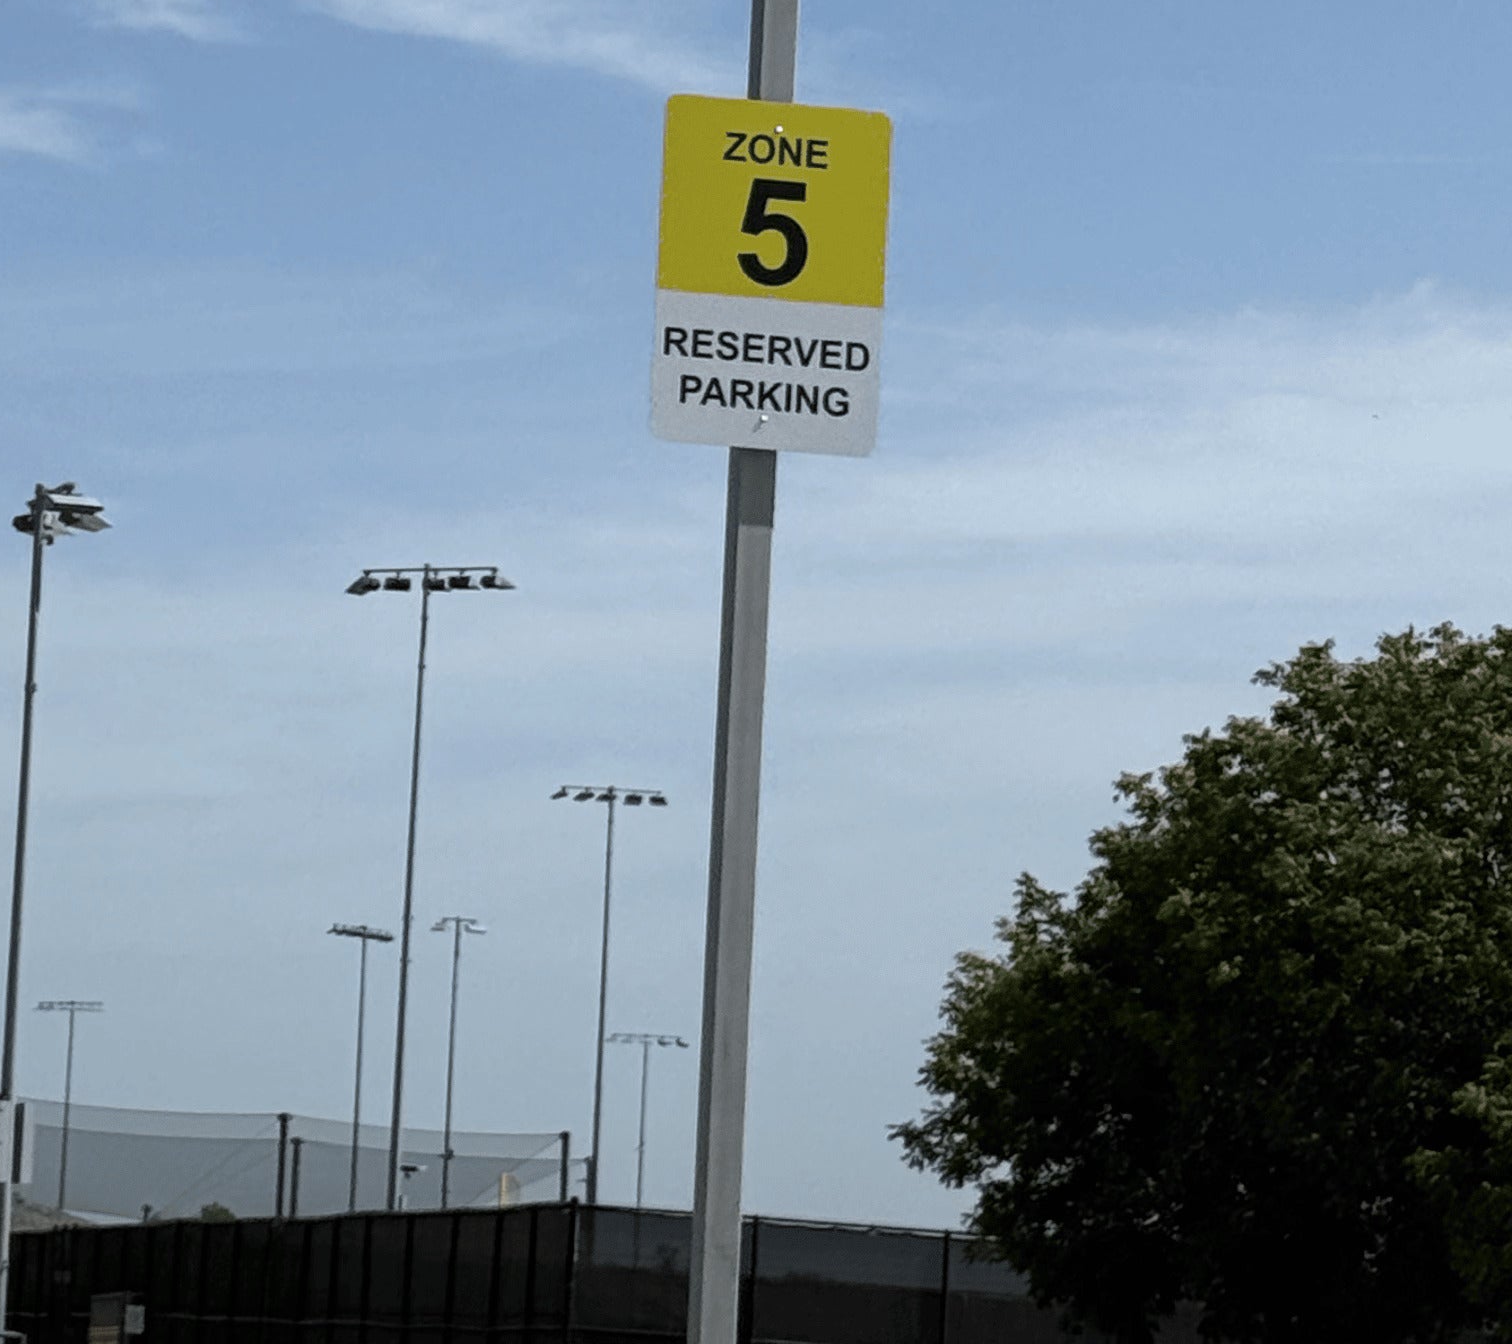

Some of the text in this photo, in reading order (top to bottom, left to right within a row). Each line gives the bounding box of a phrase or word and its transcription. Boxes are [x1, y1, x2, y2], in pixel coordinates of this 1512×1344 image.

[723, 131, 829, 170] ZONE
[737, 178, 808, 287] 5
[663, 326, 871, 372] RESERVED
[678, 374, 850, 418] PARKING
